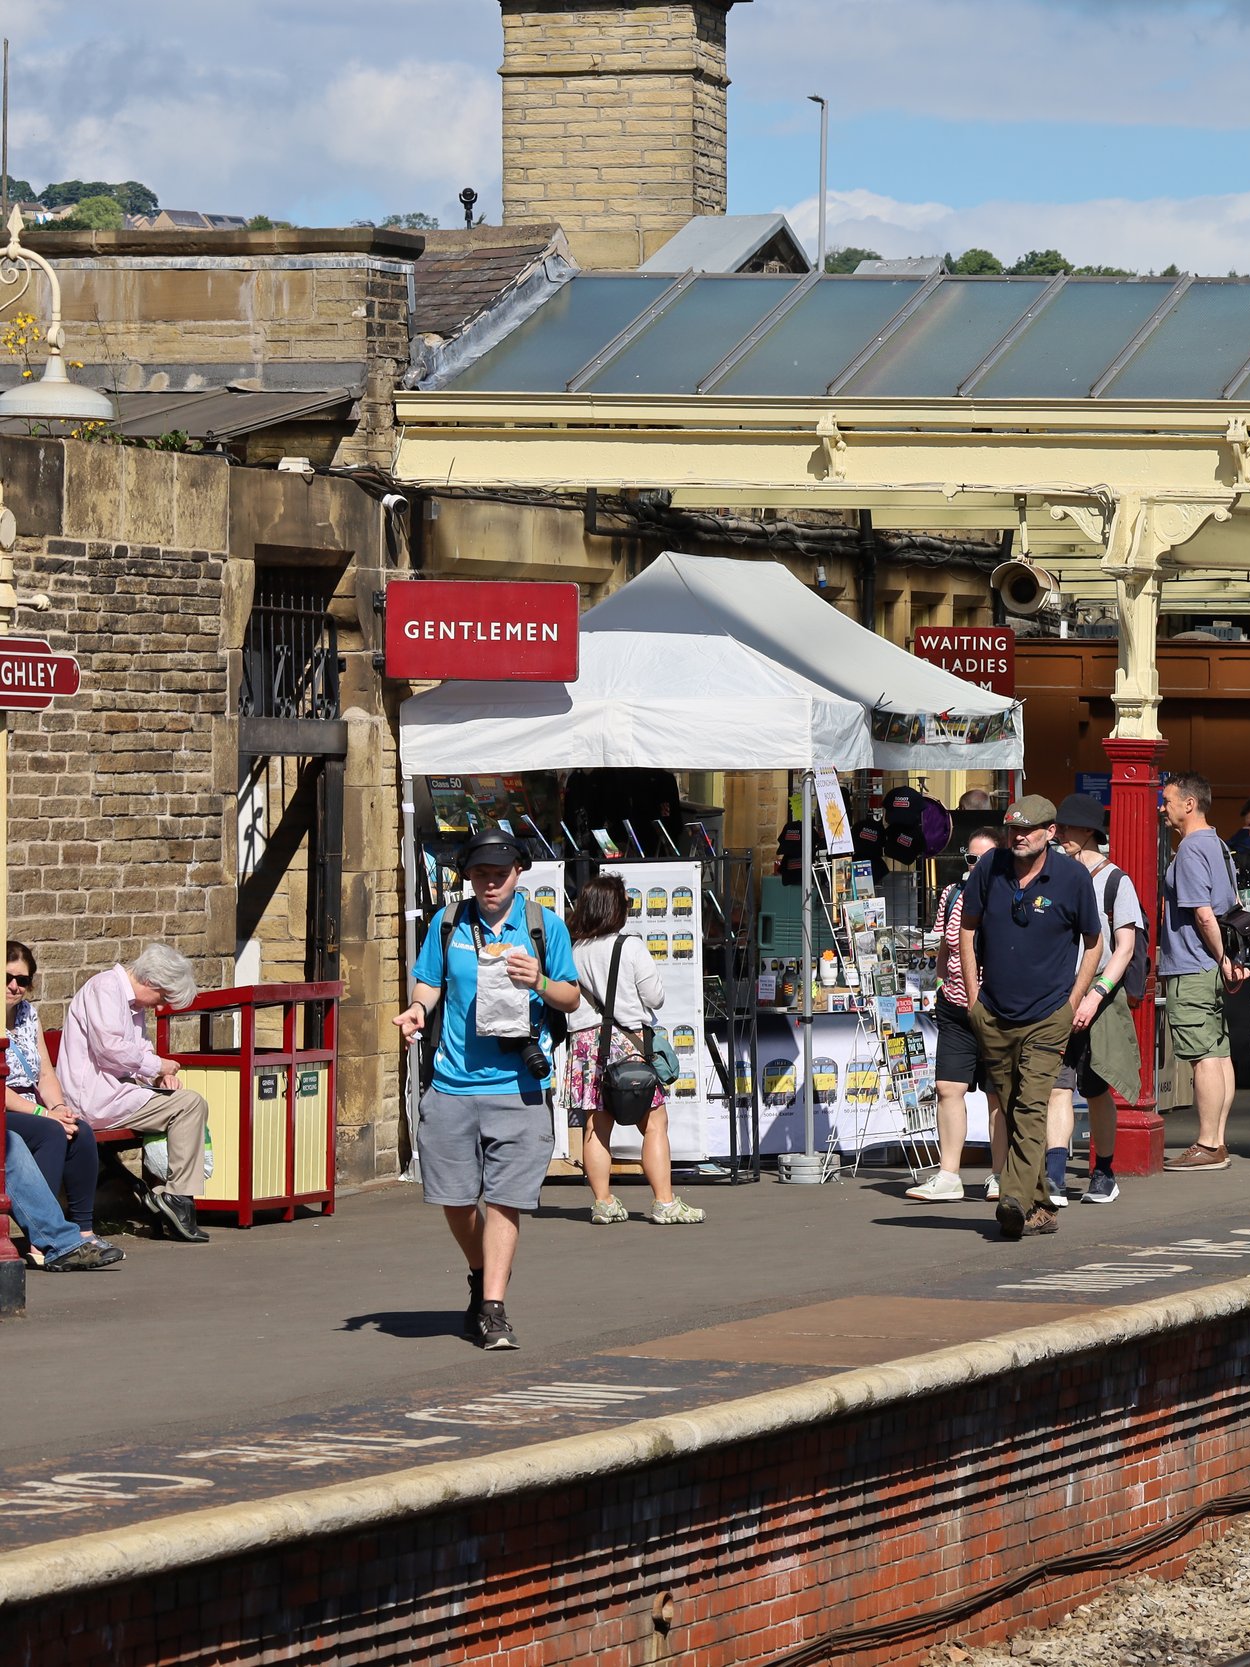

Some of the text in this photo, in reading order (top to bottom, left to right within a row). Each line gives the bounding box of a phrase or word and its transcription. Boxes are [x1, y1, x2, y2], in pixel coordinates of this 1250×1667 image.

[404, 620, 558, 641] GENTLEMEN
[920, 635, 1008, 651] WAITING
[942, 658, 1008, 673] LADIES
[431, 777, 462, 788] Class 50
[474, 925, 483, 949] Canon
[996, 1262, 1194, 1292] MIND
